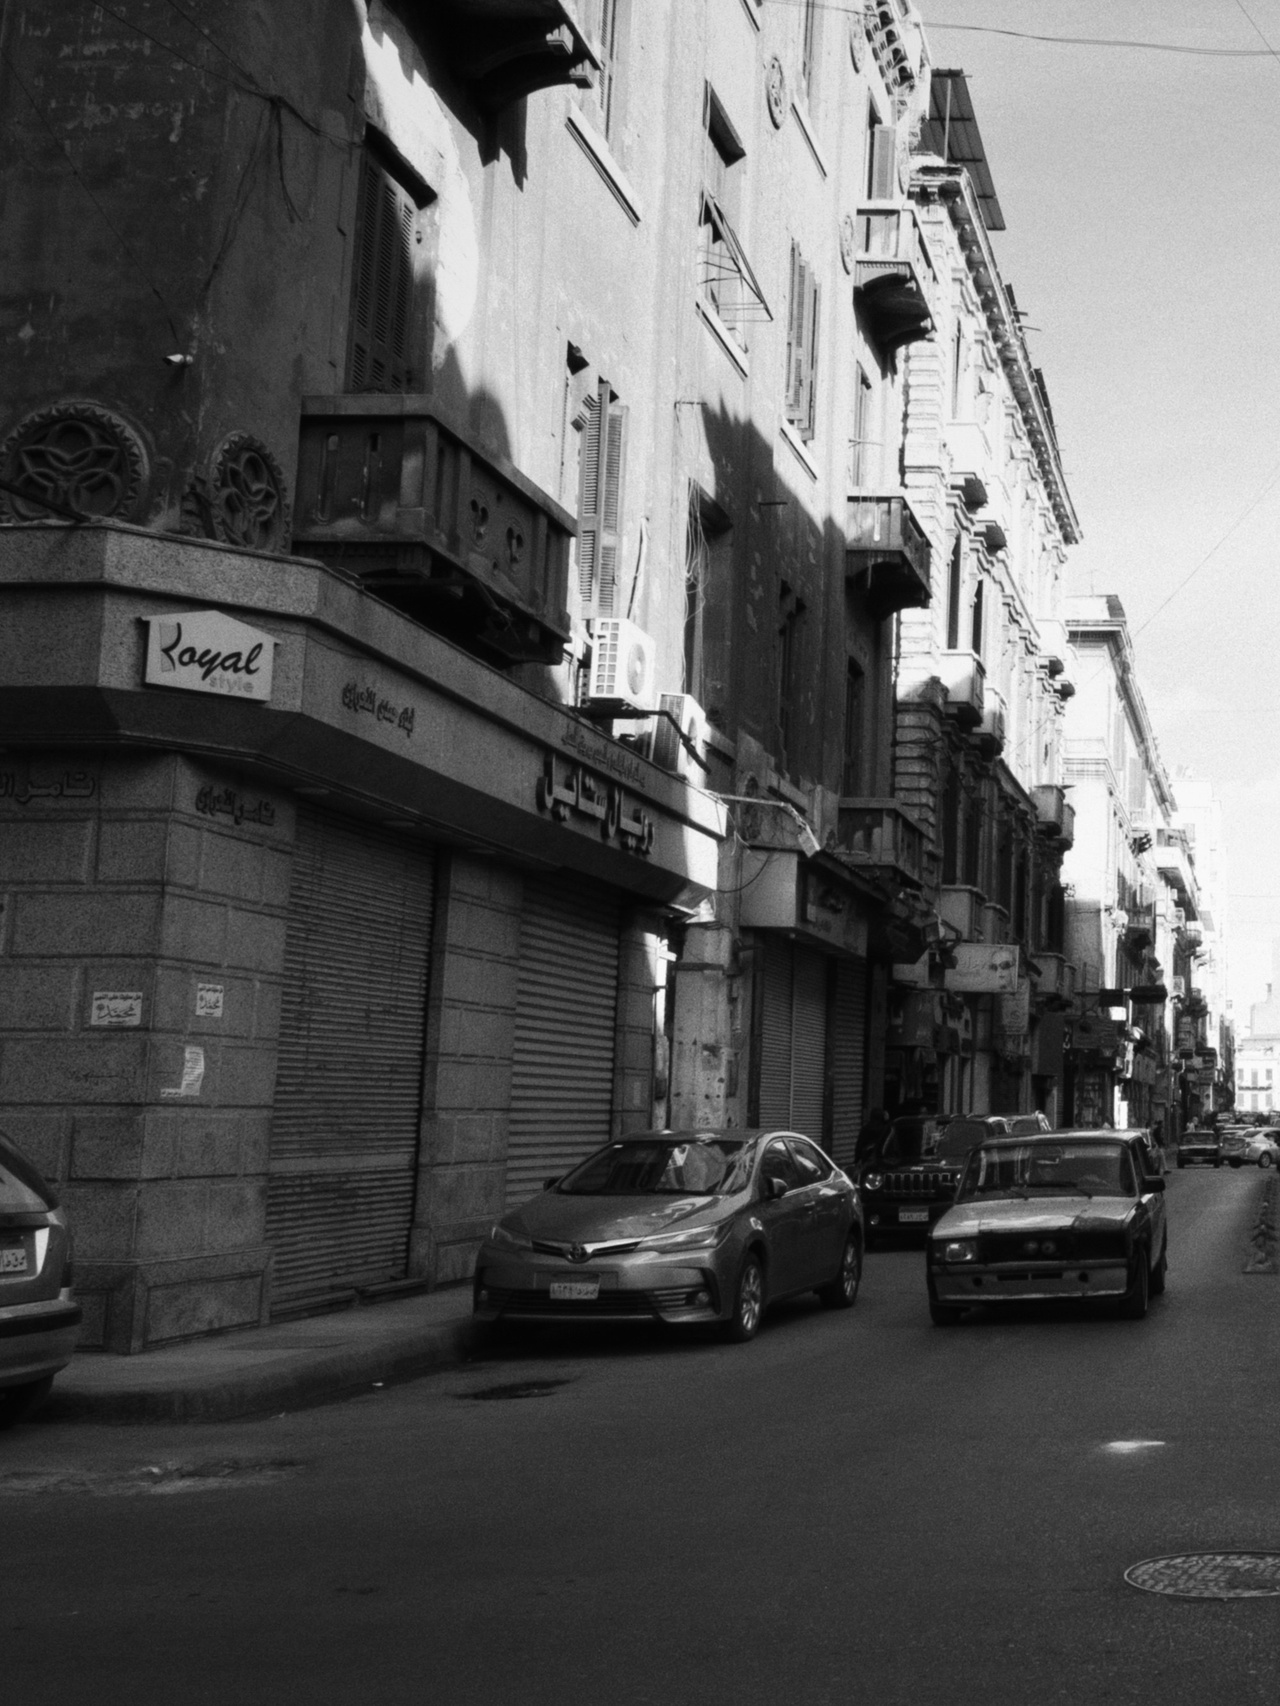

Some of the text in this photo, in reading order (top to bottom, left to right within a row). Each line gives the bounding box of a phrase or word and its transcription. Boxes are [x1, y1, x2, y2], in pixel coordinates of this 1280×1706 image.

[160, 622, 264, 681] Royal
[208, 674, 254, 693] style
[14, 769, 96, 806] تامر
[539, 752, 607, 820] ستايل
[603, 785, 656, 853] رويال
